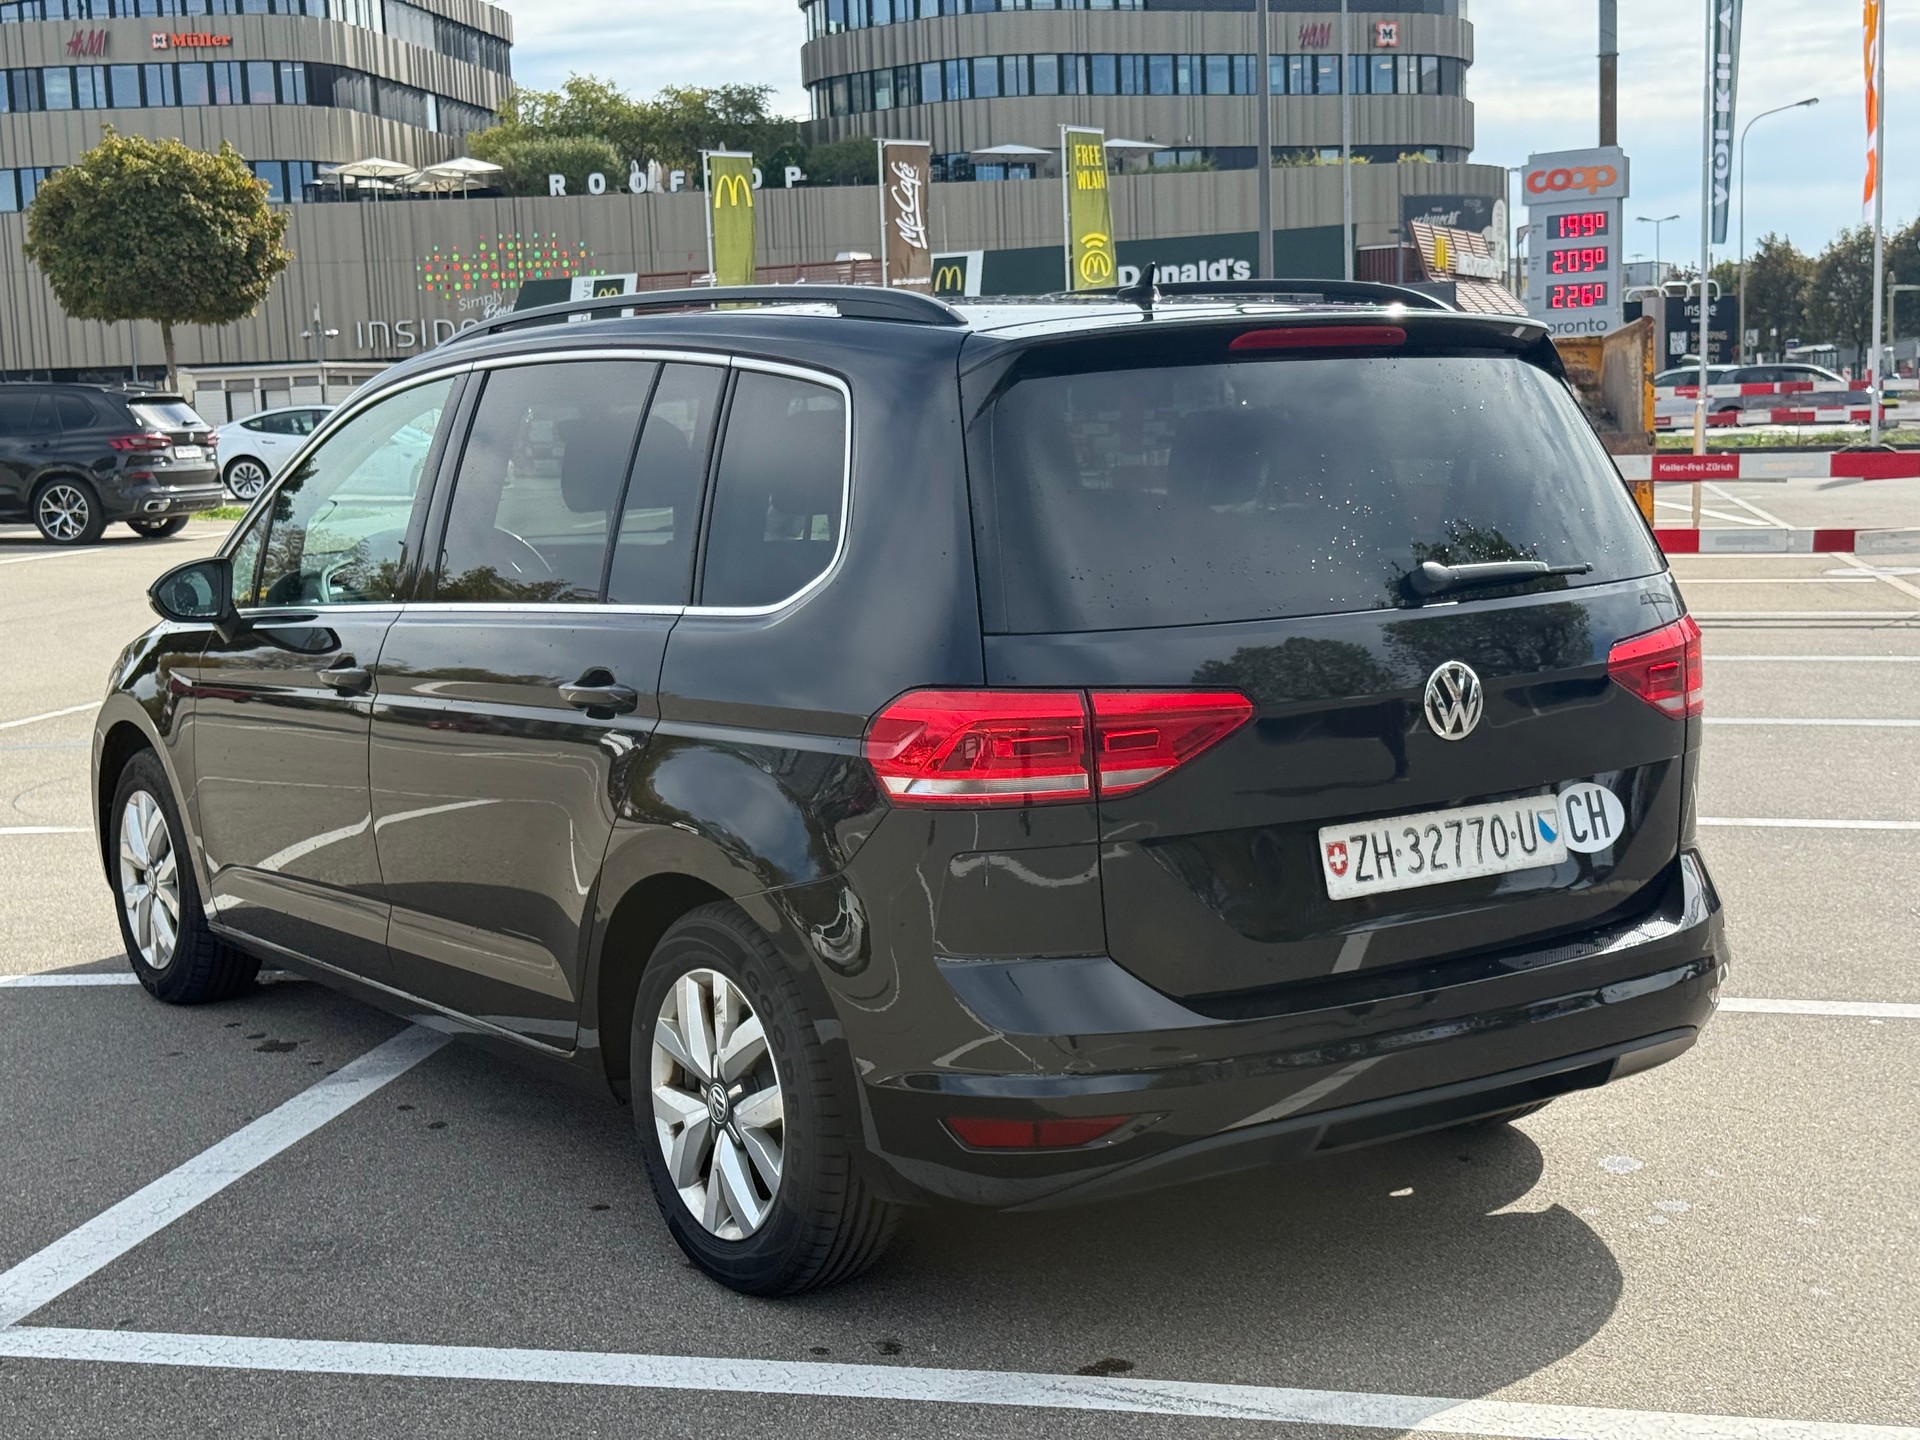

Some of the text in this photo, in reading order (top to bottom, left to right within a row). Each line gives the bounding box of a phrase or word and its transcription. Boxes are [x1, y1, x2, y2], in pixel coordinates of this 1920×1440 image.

[171, 32, 231, 47] Müller
[1075, 144, 1102, 167] FREE
[1076, 170, 1105, 190] WLAN
[1526, 165, 1617, 194] coop
[459, 290, 505, 312] Simply
[1705, 462, 1734, 471] Zürich
[1565, 788, 1611, 844] CH
